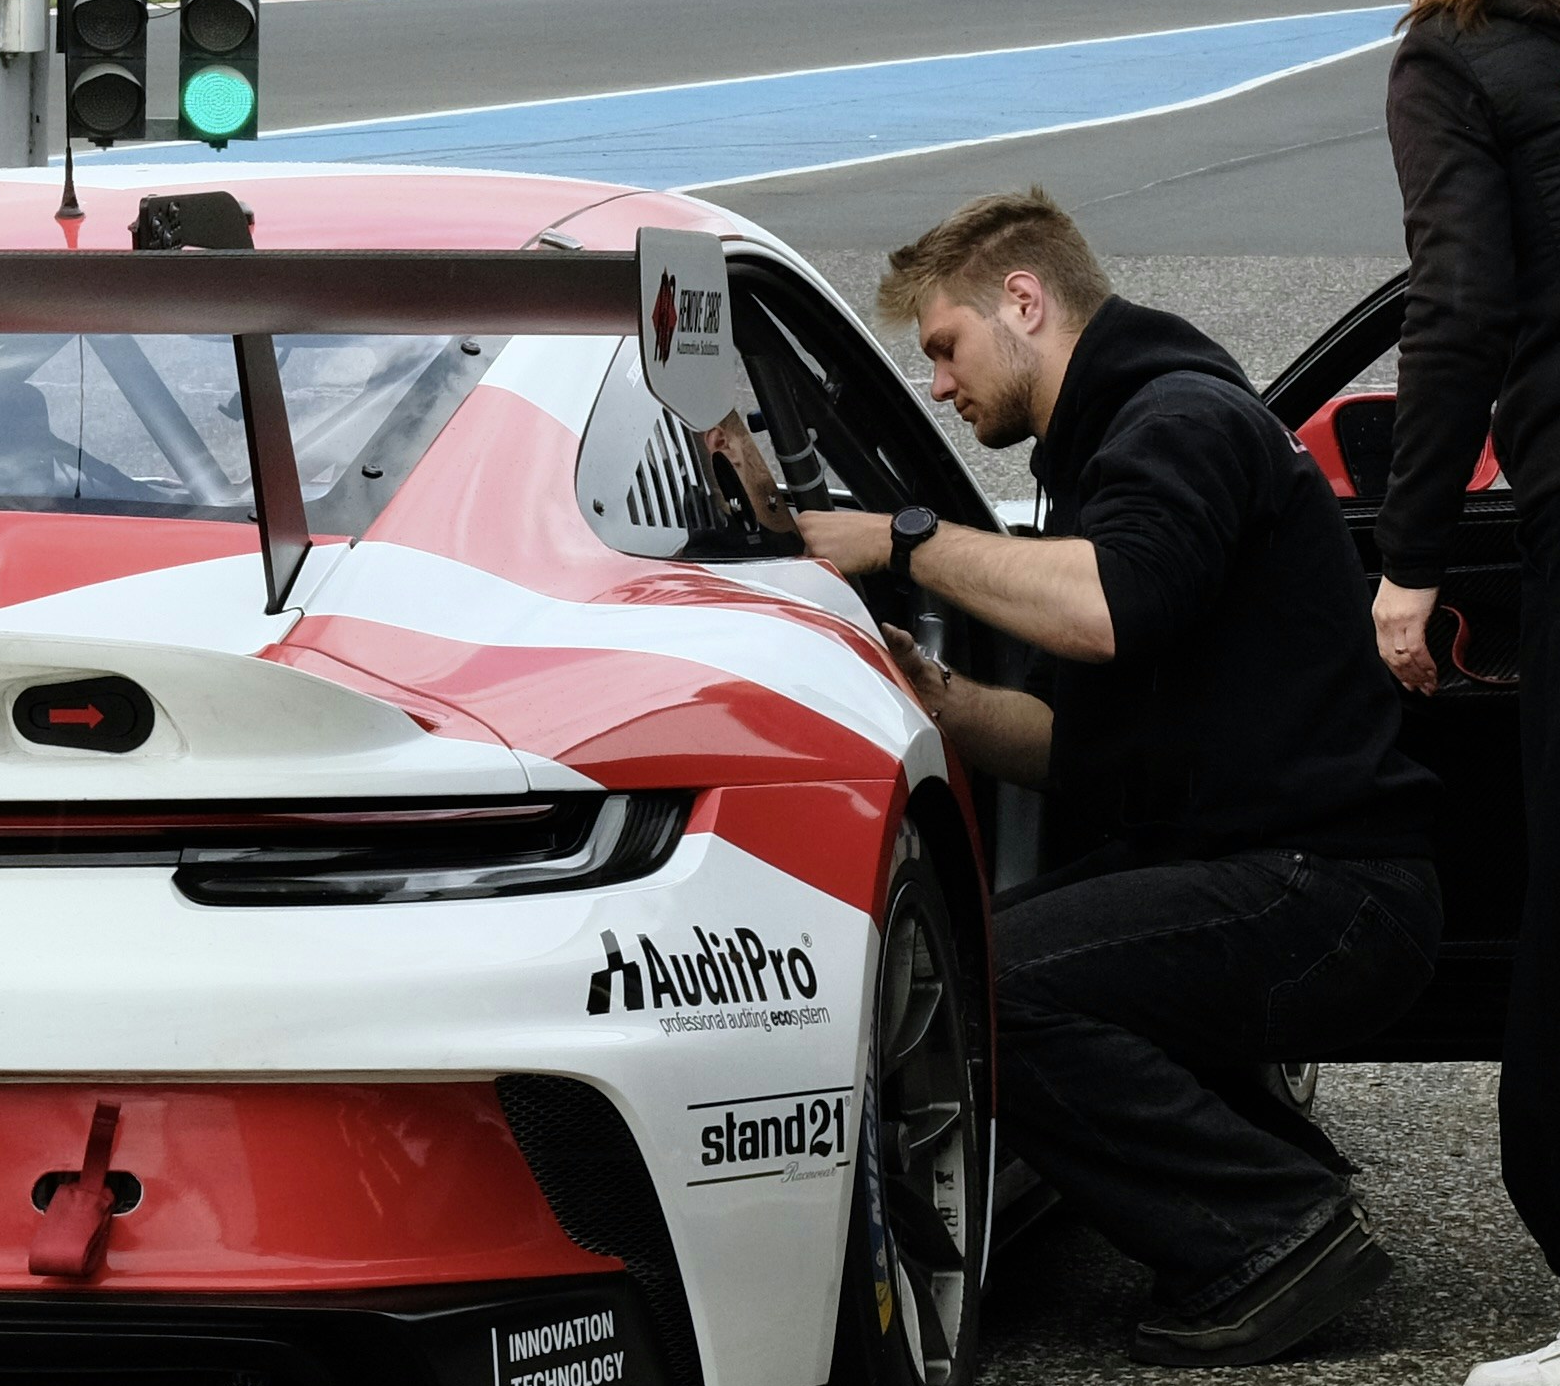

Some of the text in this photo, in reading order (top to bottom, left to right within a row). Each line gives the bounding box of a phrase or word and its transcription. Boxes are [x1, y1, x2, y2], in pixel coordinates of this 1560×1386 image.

[703, 290, 722, 334] CARS
[659, 1005, 831, 1037] professional auditing ecosystem
[781, 1161, 838, 1183] Racewear
[509, 1310, 614, 1362] INNOVATION
